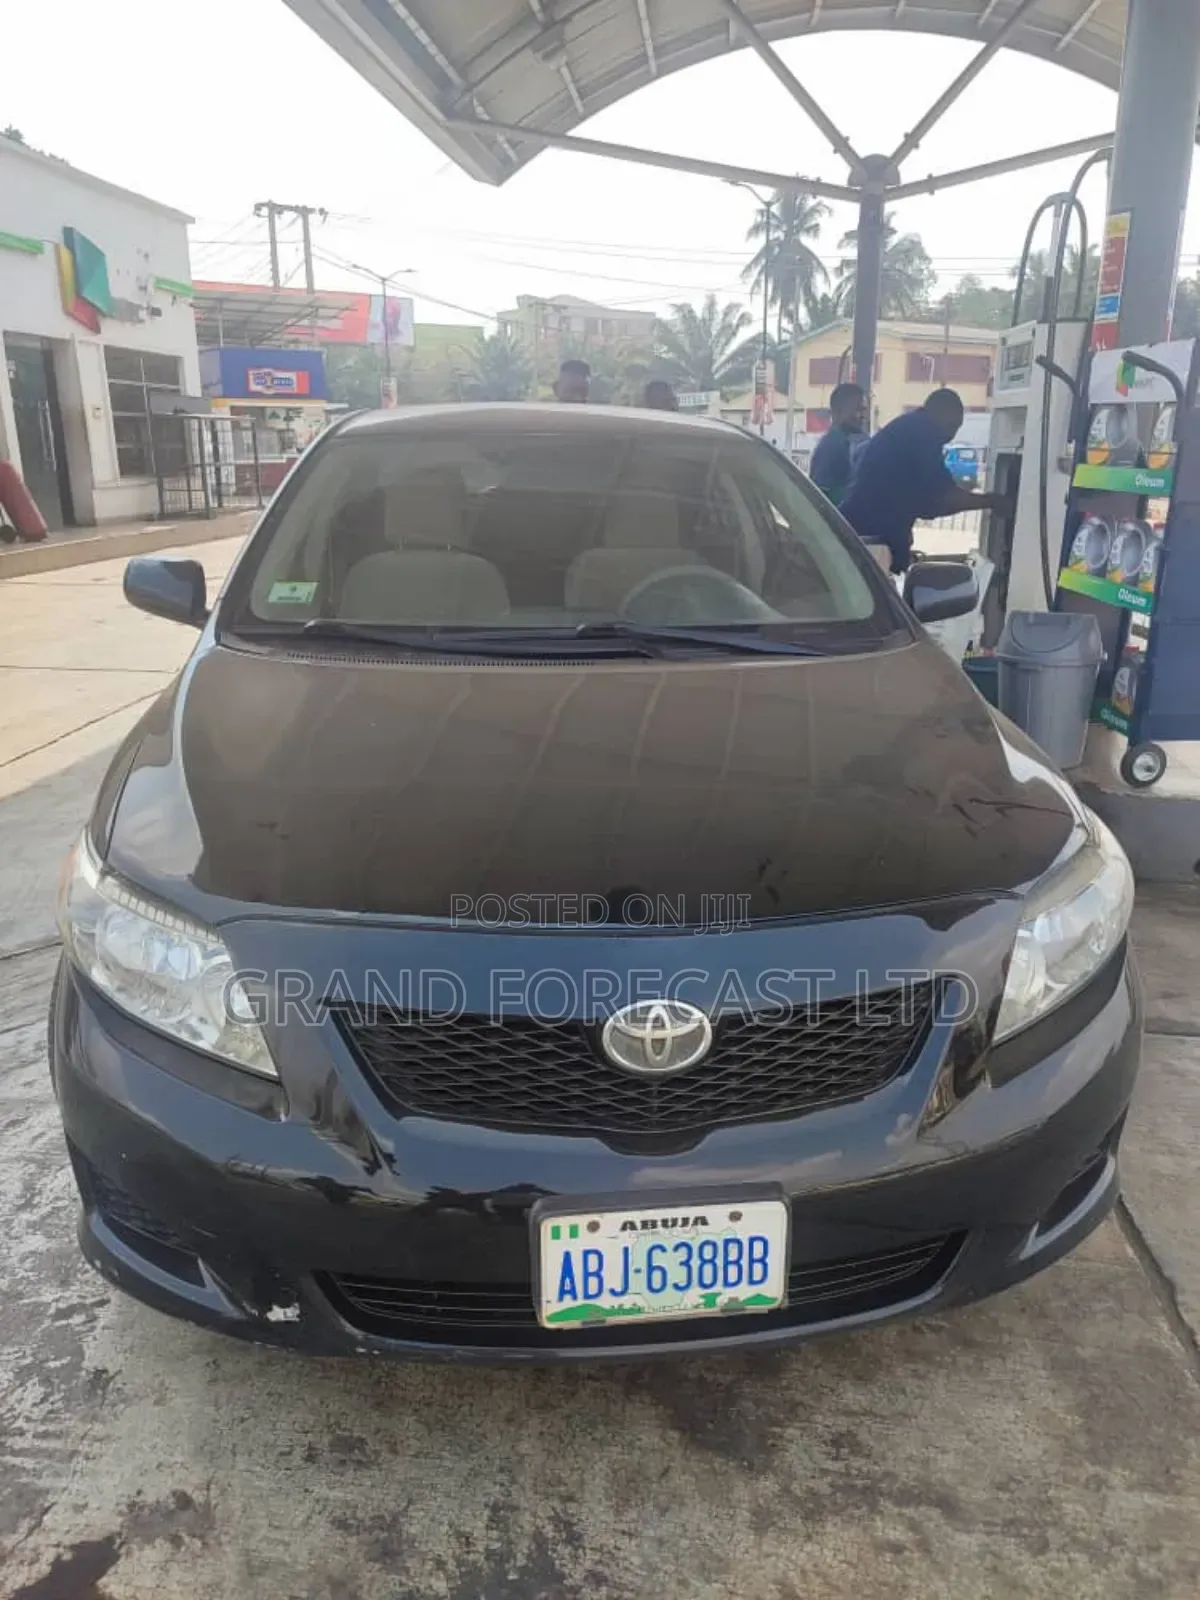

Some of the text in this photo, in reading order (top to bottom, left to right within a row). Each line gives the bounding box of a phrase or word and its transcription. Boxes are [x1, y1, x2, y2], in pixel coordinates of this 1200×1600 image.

[1135, 472, 1165, 489] Oleum
[1117, 587, 1147, 608] Oleum
[619, 1215, 711, 1232] ABUJA
[557, 1235, 770, 1303] ABJ-638BB
